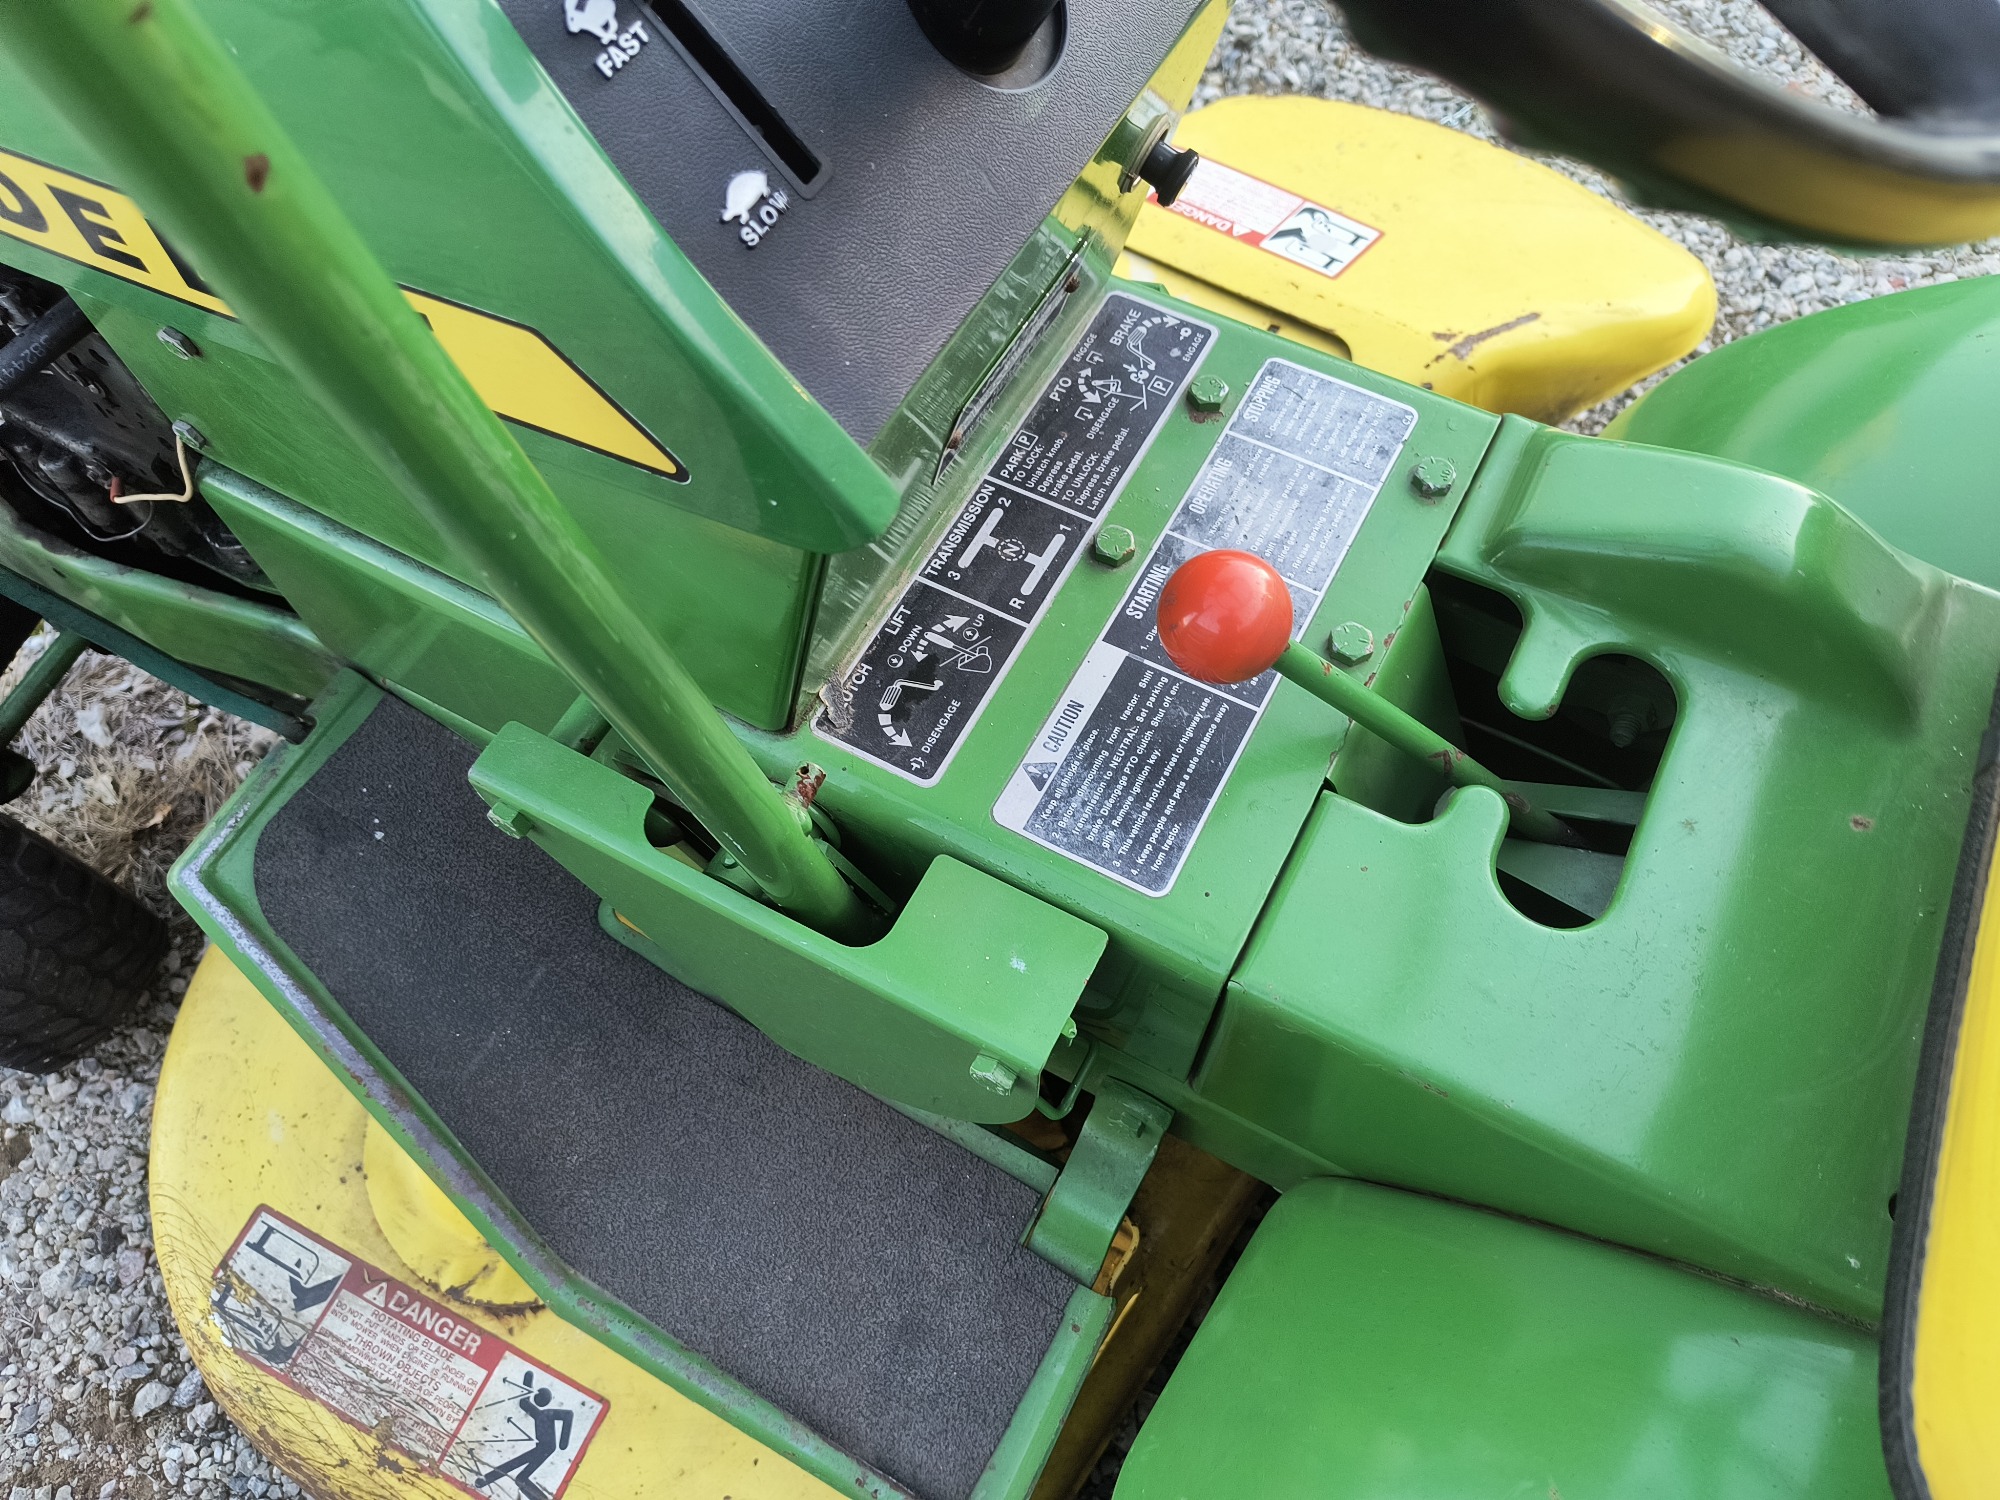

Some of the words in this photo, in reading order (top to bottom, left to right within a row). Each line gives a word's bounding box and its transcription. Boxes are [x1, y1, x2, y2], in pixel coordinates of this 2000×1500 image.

[596, 21, 649, 77] FAST
[740, 191, 791, 247] SLOW
[1172, 202, 1233, 233] DANGE
[1072, 332, 1098, 362] ENGAGE
[1109, 308, 1142, 345] BRAKE
[1181, 332, 1205, 361] ENGAGE
[1048, 376, 1073, 401] PTO
[1153, 380, 1168, 391] P
[1241, 374, 1281, 422] STOPPING
[1085, 396, 1120, 440] DISENGAGE
[1401, 414, 1412, 425] CA
[998, 448, 1026, 478] PARK
[1017, 434, 1031, 445] P
[1012, 469, 1027, 483] TO
[1021, 443, 1045, 469] LOCK:
[1025, 457, 1051, 488] Unlatch
[1045, 435, 1065, 457] knob.
[1037, 460, 1065, 492] Depress
[1048, 473, 1069, 496] brake
[1063, 449, 1086, 474] pedal.
[1062, 487, 1077, 501] TO
[1070, 450, 1100, 488] UNLOCK:
[1074, 472, 1102, 506] Depress
[1094, 449, 1115, 472] brake
[1109, 425, 1131, 450] pedal.
[997, 496, 1012, 507] 2
[1086, 486, 1107, 510] Latch
[1101, 463, 1122, 486] knob.
[1187, 456, 1233, 515] OPERATING
[924, 483, 996, 578] TRANSMISSION
[1002, 542, 1021, 557] N
[1058, 523, 1072, 533] 1
[946, 569, 962, 581] 3
[1124, 561, 1171, 620] STARTING
[884, 604, 913, 635] LIFT
[972, 613, 987, 627] UP
[1008, 596, 1026, 609] R
[898, 623, 923, 653] DOWN
[836, 662, 874, 707] UTCH
[1199, 694, 1212, 711] use.
[920, 698, 961, 754] DISENGAGE
[1041, 698, 1085, 753] CAUTION
[1179, 711, 1204, 744] highway
[1051, 830, 1061, 838] 2.
[1057, 801, 1077, 827] Before
[1075, 748, 1109, 797] dismounting
[1105, 725, 1122, 744] from
[1119, 692, 1140, 721] tractor:
[1137, 669, 1153, 688] Shift
[1071, 780, 1107, 835] transmission
[1103, 770, 1113, 779] to
[1109, 723, 1140, 768] NEUTRAL.
[1135, 708, 1149, 722] Set
[1144, 675, 1169, 707] parking
[1086, 815, 1105, 841] brake.
[1100, 774, 1130, 816] Disengage
[1123, 755, 1139, 774] PTO
[1134, 727, 1155, 754] clutch.
[1150, 707, 1166, 727] Shut
[1161, 695, 1173, 708] off
[1161, 753, 1179, 776] street
[1175, 743, 1185, 753] or
[1040, 798, 1058, 820] Keep
[1053, 787, 1064, 798] all
[1059, 760, 1080, 787] shields
[1076, 750, 1085, 759] in
[1081, 726, 1101, 751] place.
[1130, 866, 1140, 875] 4.
[1135, 842, 1154, 865] Keep
[1147, 815, 1169, 844] people
[1162, 798, 1177, 815] and
[1171, 780, 1188, 799] pets
[1185, 755, 1200, 773] safe
[1194, 723, 1218, 755] distance
[1213, 702, 1230, 723] away
[1147, 788, 1160, 802] not
[1154, 775, 1167, 788] for
[1100, 827, 1118, 848] gine.
[1111, 795, 1134, 827] Remove
[1129, 764, 1153, 795] ignition
[1146, 746, 1163, 765] key.
[1142, 801, 1153, 810] is
[1127, 809, 1148, 838] vehicle
[1150, 850, 1166, 871] from
[1160, 820, 1182, 851] tractor.
[1112, 857, 1122, 867] 3.
[1117, 837, 1133, 856] This
[335, 1300, 347, 1311] DO
[347, 1307, 363, 1320] NOT
[364, 1317, 379, 1329] PUT
[380, 1327, 406, 1345] HANDS
[406, 1342, 419, 1353] OR
[419, 1349, 439, 1364] FEET
[440, 1362, 466, 1381] UNDER
[466, 1377, 478, 1388] OR
[370, 1308, 421, 1343] ROTATING
[421, 1338, 455, 1362] BLADE
[387, 1289, 483, 1356] DANGER
[330, 1308, 348, 1322] INTO
[350, 1319, 378, 1340] MOWER
[379, 1337, 401, 1354] WHEN
[402, 1350, 429, 1370] ENGINE
[430, 1367, 440, 1376] IS
[439, 1372, 474, 1396] RUNNING
[352, 1333, 396, 1364] THROWN
[395, 1358, 441, 1391] OBJECTS
